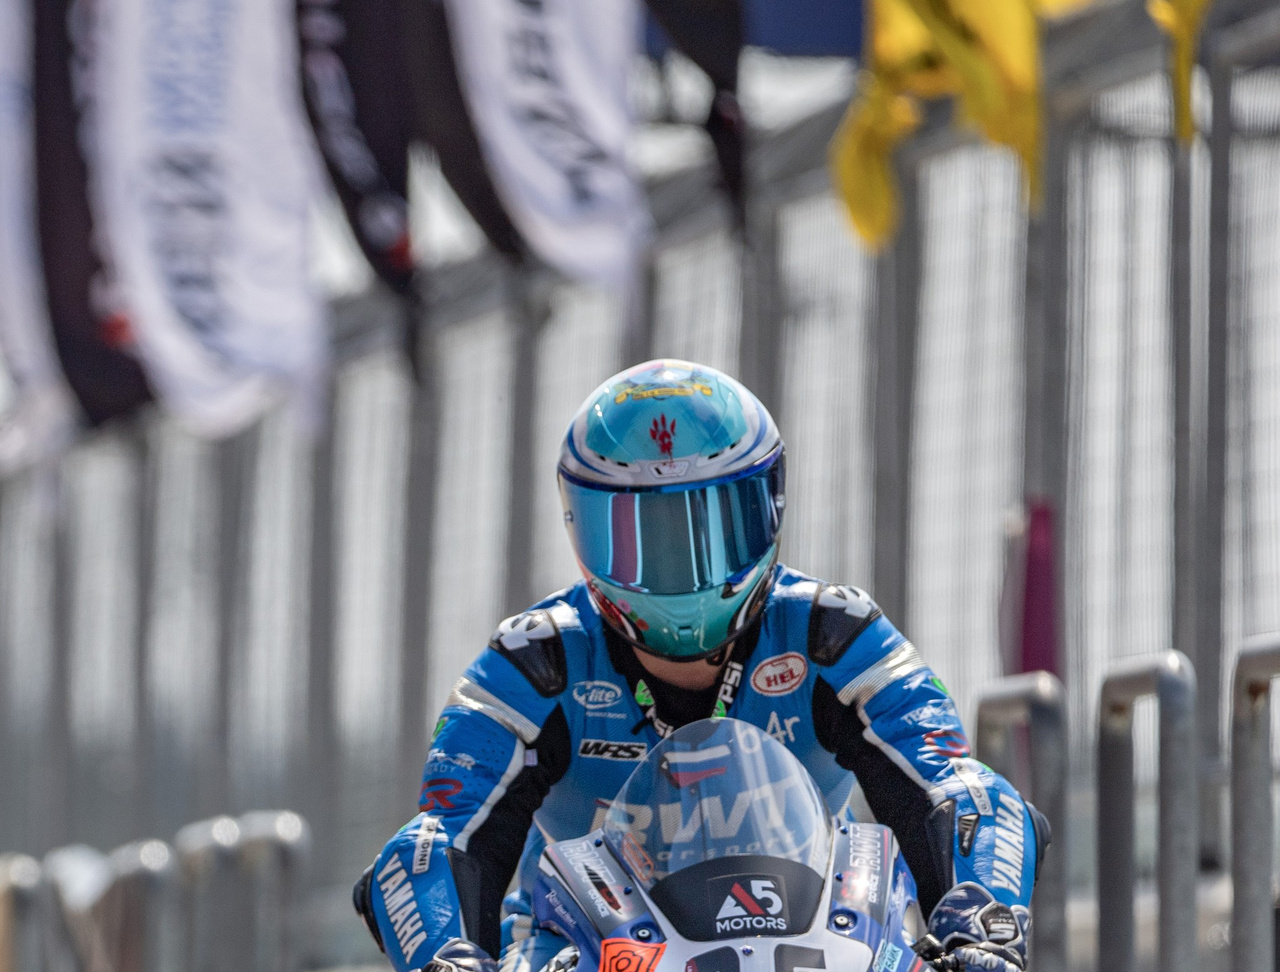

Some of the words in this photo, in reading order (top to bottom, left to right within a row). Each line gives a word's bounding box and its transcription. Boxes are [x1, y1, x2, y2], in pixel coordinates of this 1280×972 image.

[580, 741, 646, 759] WRS
[991, 792, 1024, 898] YAMAHA
[376, 852, 427, 965] YAMAHA
[716, 915, 787, 933] MOTORS
